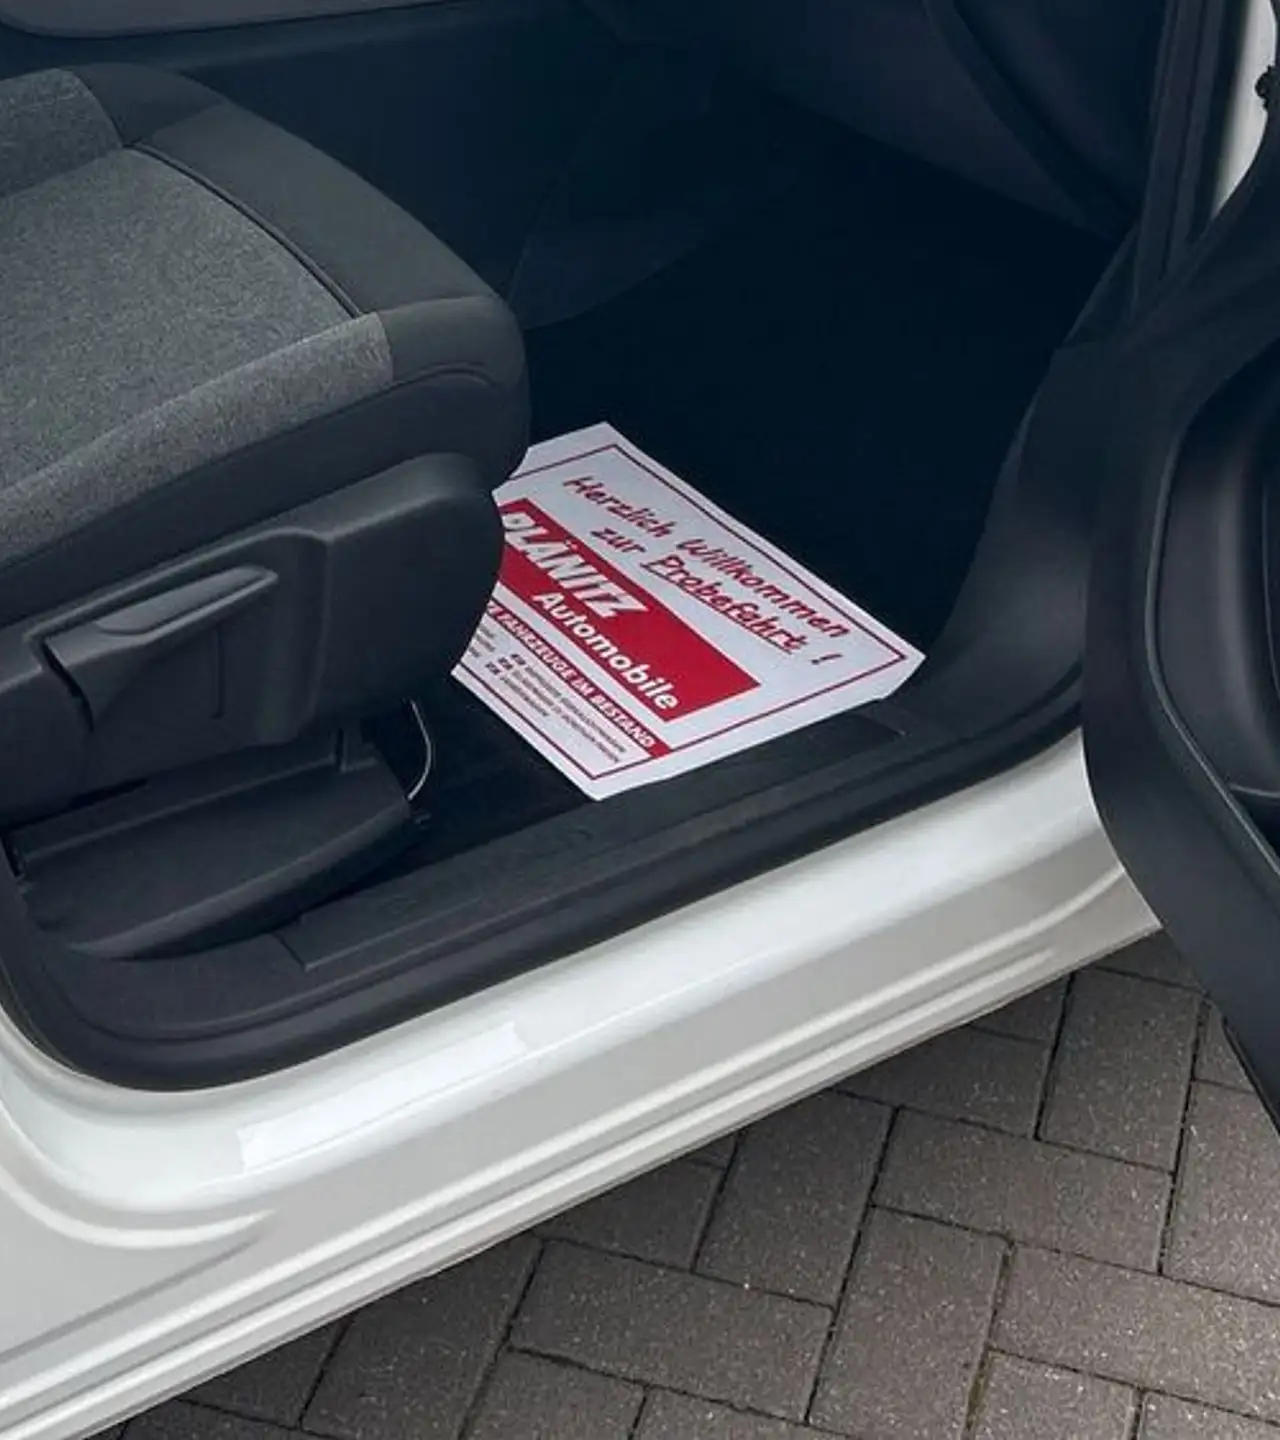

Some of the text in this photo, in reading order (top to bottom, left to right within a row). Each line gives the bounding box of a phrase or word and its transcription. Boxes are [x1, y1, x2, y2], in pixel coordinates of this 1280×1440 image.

[563, 475, 678, 538] Herzlich
[589, 528, 844, 666] zur Probefahrt !
[532, 593, 679, 709] Automobile
[589, 694, 657, 748] BESTAND
